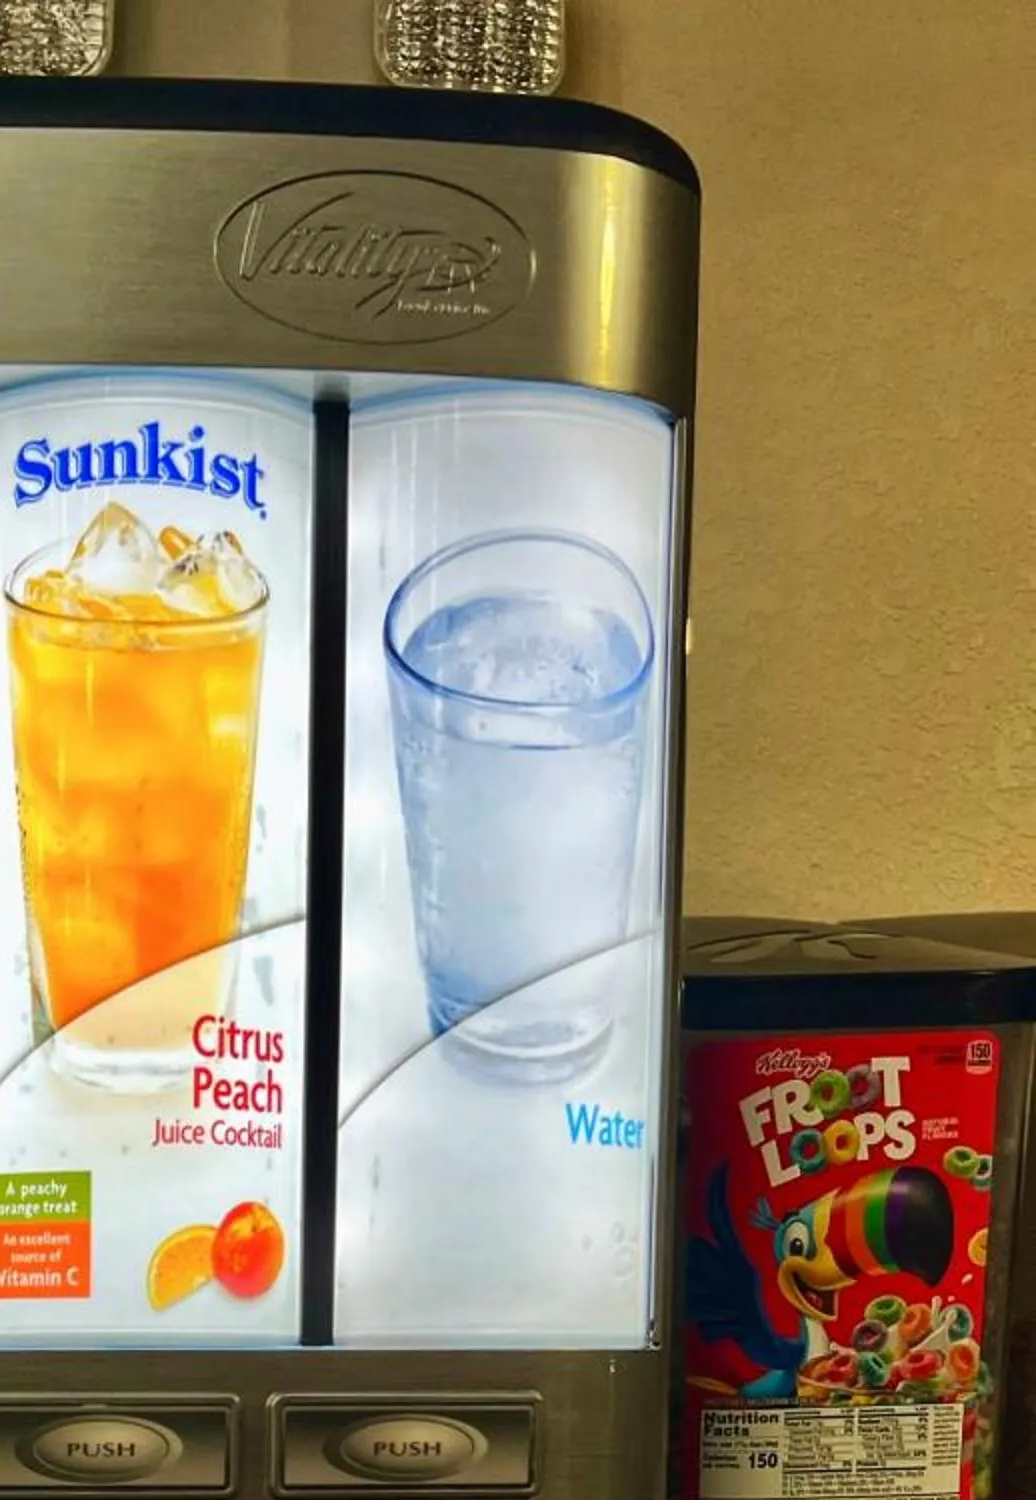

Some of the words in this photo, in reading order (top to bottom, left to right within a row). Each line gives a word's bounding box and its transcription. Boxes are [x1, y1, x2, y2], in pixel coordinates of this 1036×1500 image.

[14, 421, 268, 520] Sunkist
[191, 1014, 284, 1063] Citrus
[191, 1066, 283, 1114] Peach
[739, 1056, 910, 1147] FROOT
[151, 1117, 205, 1147] Juice
[210, 1119, 283, 1150] Cocktail
[566, 1103, 645, 1150] Water
[760, 1109, 916, 1187] LOOPS
[5, 1180, 16, 1196] A
[20, 1178, 67, 1201] peachy
[43, 1199, 78, 1215] treat
[19, 1232, 71, 1246] excellent
[67, 1266, 80, 1287] C
[704, 1411, 779, 1425] Nutrition
[704, 1425, 750, 1437] Facts
[66, 1441, 136, 1459] PUSH
[372, 1439, 442, 1458] PUSH
[748, 1452, 778, 1469] 150
